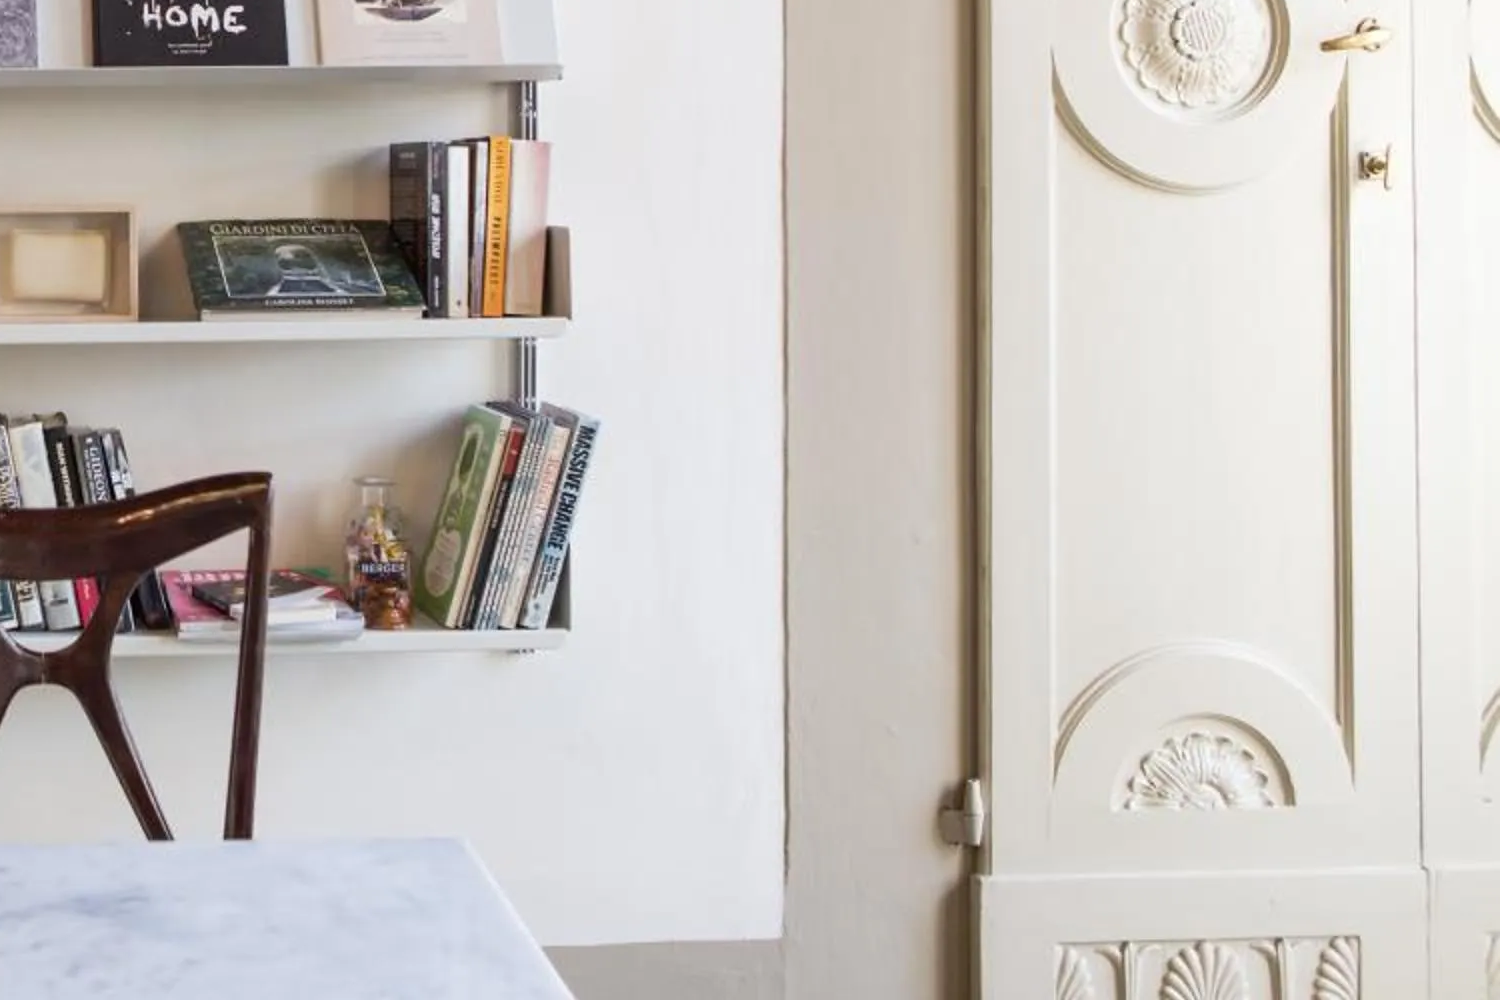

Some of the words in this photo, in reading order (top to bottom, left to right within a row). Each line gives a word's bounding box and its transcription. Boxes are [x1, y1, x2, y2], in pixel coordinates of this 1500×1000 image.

[143, 3, 248, 35] HOME
[209, 223, 287, 235] GIARDINI
[291, 223, 307, 235] DI
[563, 424, 597, 493] MASSIVE
[547, 492, 577, 552] CHANGE
